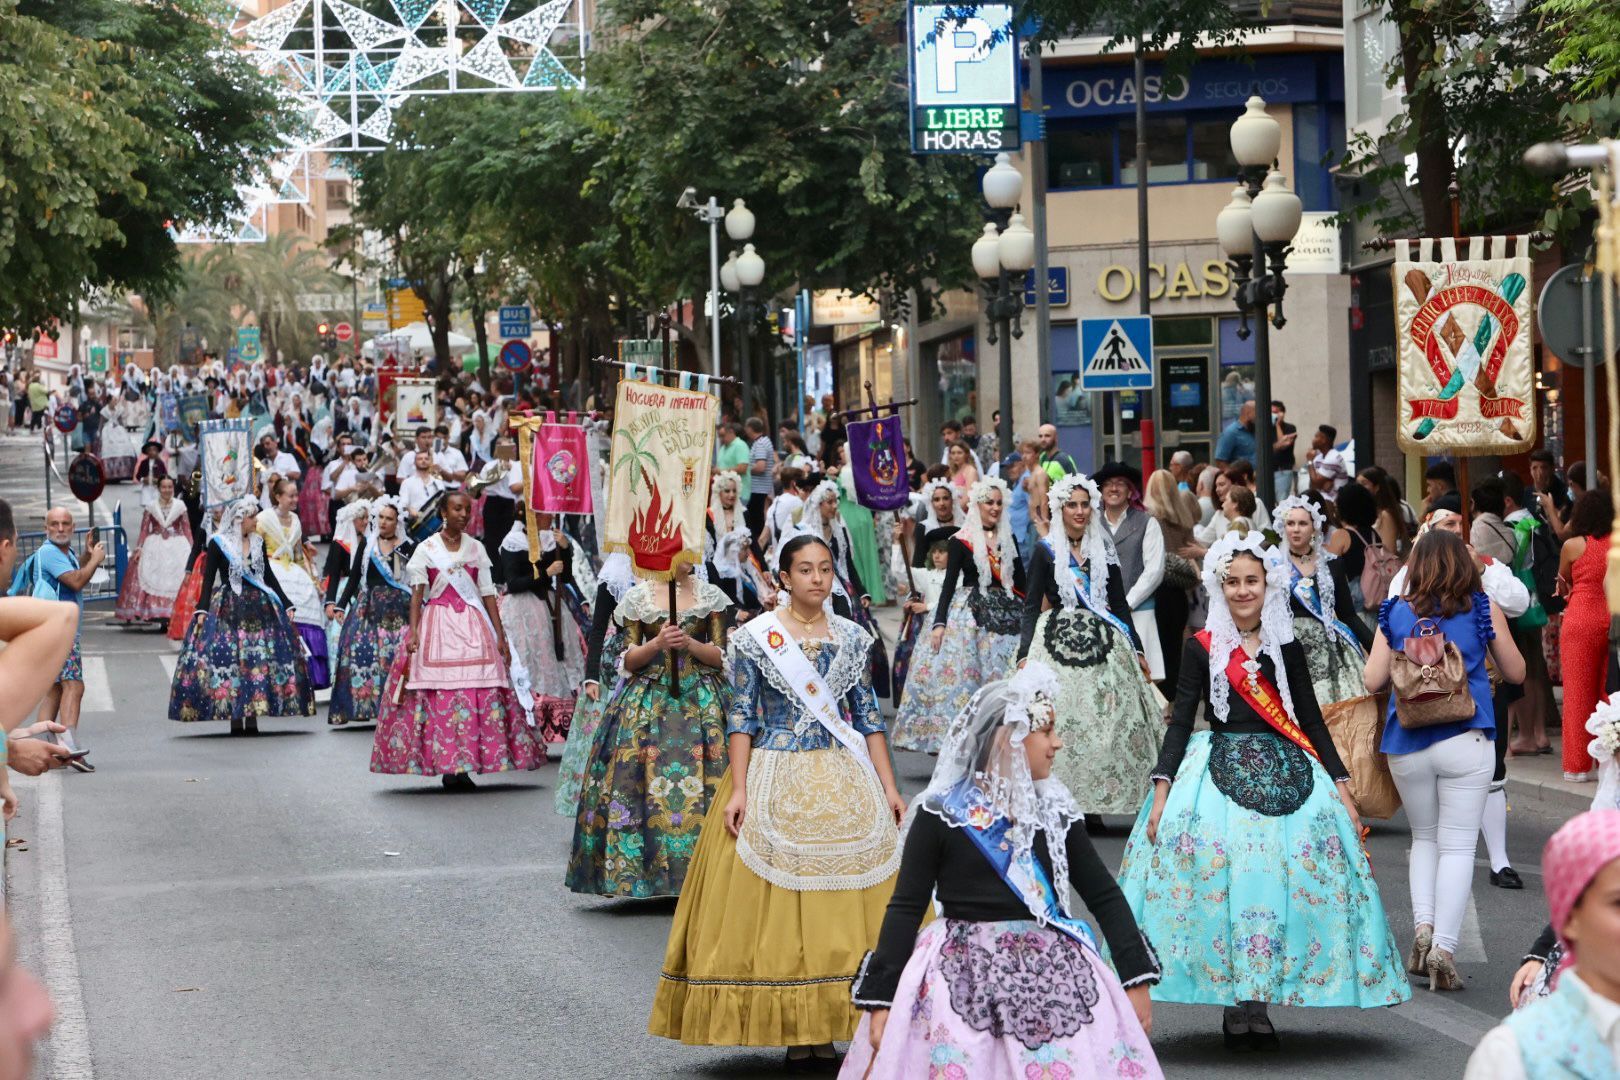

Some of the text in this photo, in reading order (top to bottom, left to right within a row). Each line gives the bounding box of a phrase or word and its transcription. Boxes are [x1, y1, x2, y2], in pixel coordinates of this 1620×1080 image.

[935, 17, 992, 93] P
[1203, 78, 1289, 99] SEGUROS
[927, 108, 1004, 129] LIBRE
[923, 130, 1002, 150] HORAS
[1099, 259, 1239, 302] OCAS
[502, 309, 526, 319] BUS
[503, 326, 528, 336] TAXI
[626, 386, 709, 411] HOGUERA INFANTIL
[628, 410, 661, 436] BENITO
[662, 431, 708, 456] GALDOS
